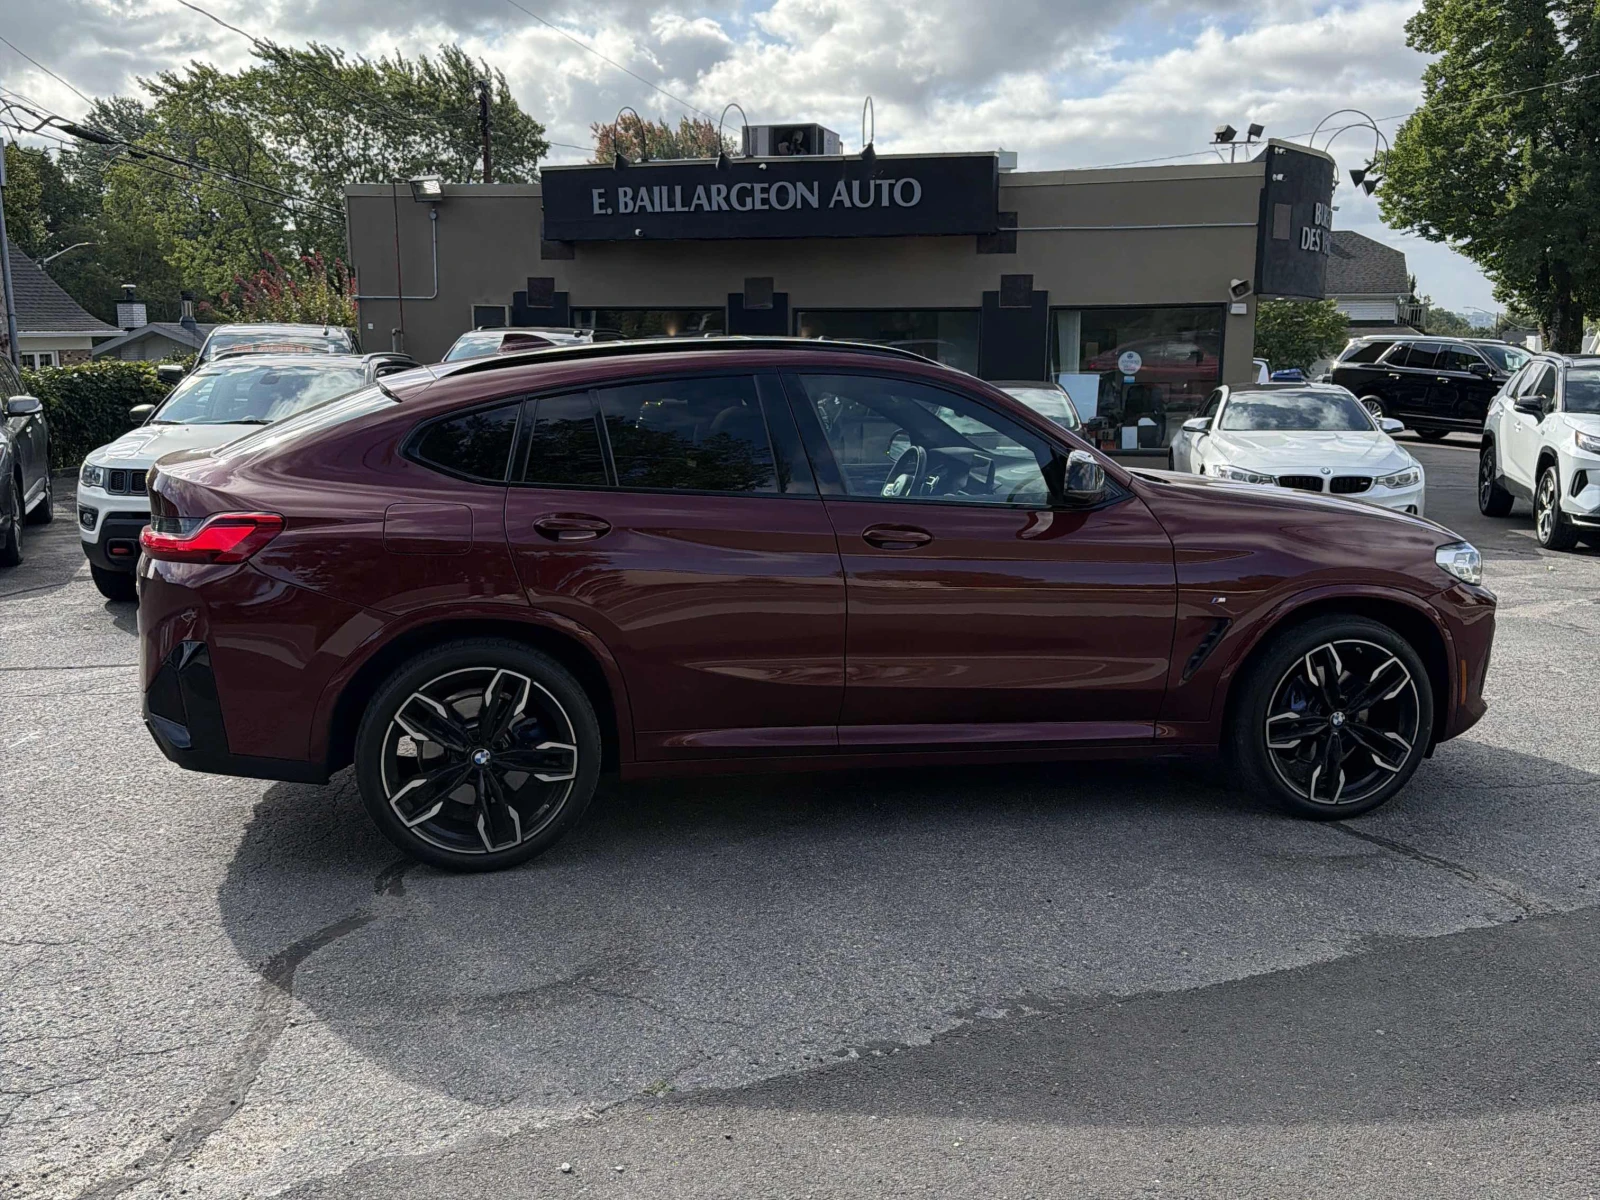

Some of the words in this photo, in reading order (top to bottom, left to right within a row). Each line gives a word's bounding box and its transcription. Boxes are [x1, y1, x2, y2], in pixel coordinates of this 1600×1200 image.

[592, 188, 613, 215] E.
[618, 181, 819, 214] BAILLARGEON
[828, 177, 922, 208] AUTO
[1301, 226, 1320, 251] DES
